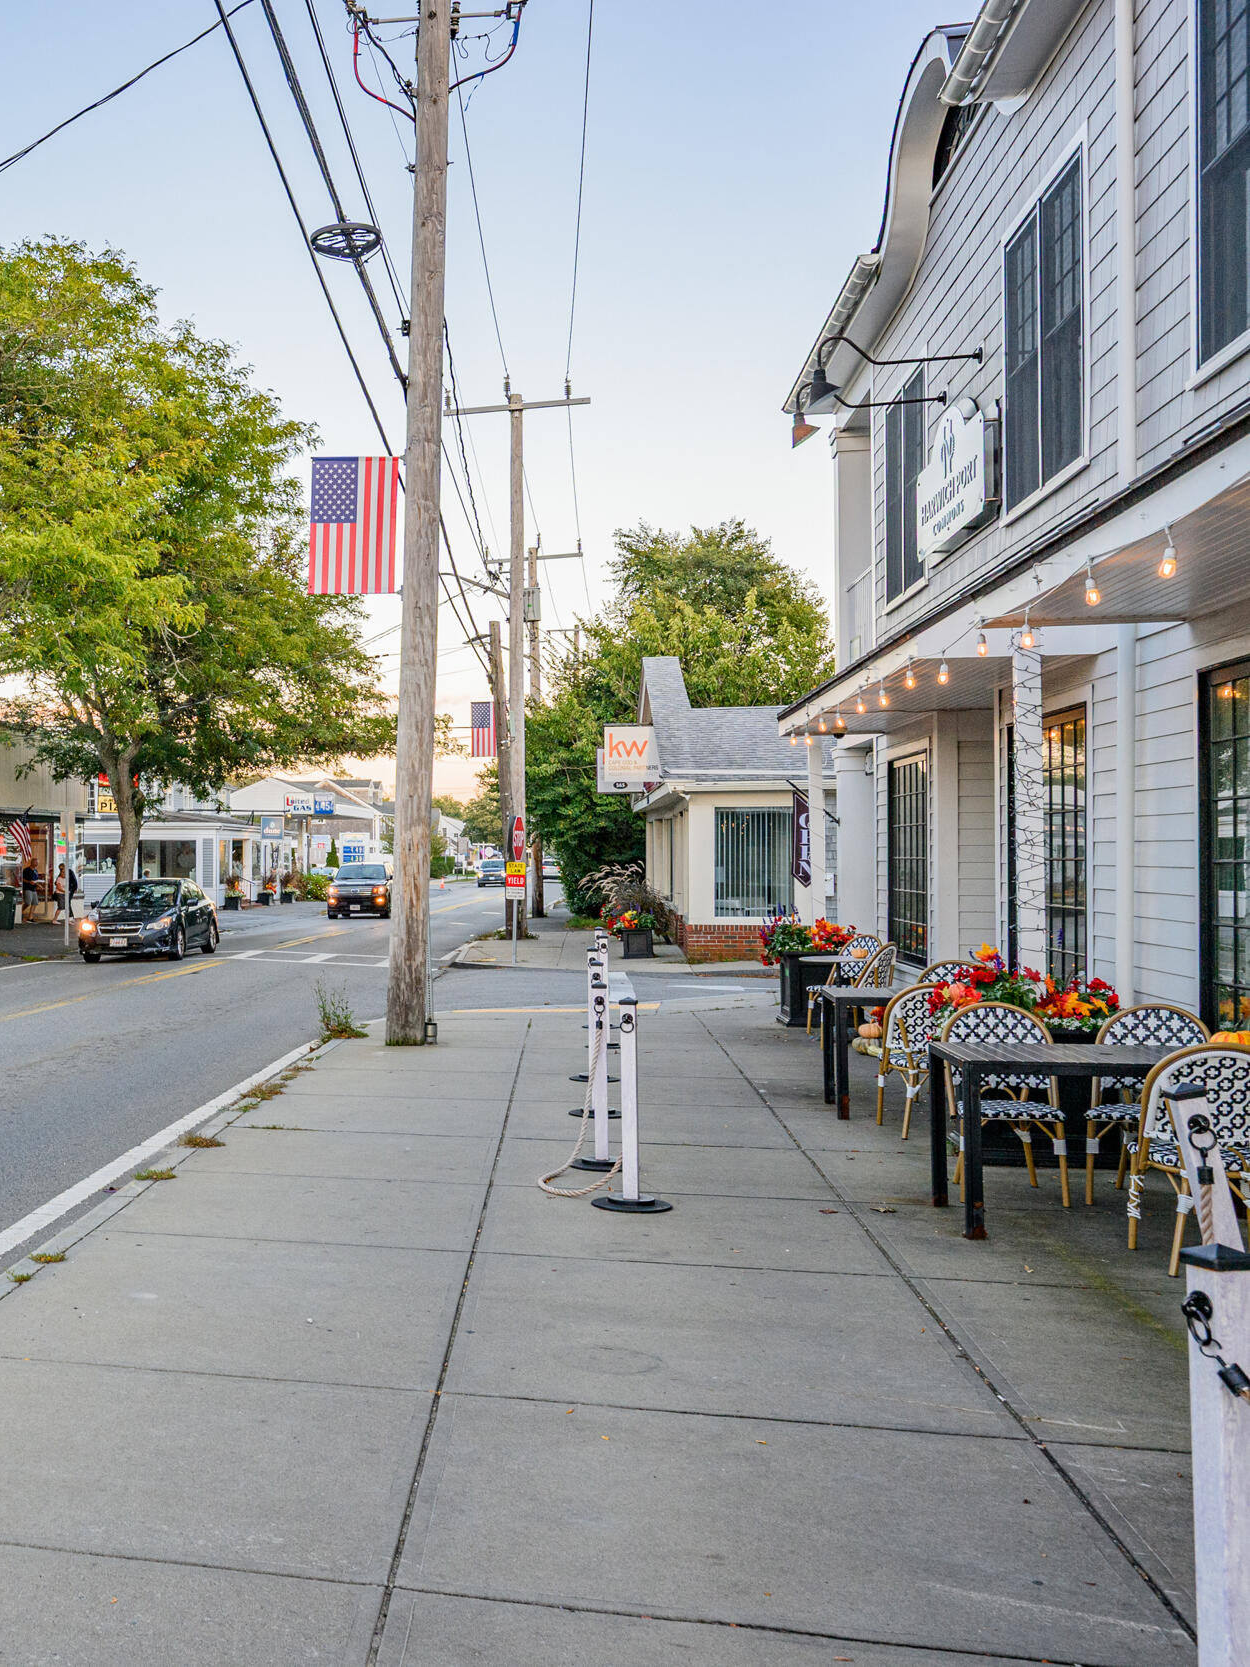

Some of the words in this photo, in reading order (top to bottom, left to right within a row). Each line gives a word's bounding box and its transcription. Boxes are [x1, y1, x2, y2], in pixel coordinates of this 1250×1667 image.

[921, 476, 956, 527] HARWICH
[956, 454, 979, 494] PORT
[933, 499, 965, 536] COMMONS
[286, 796, 310, 806] United
[293, 804, 312, 812] GAS
[513, 830, 524, 847] STOP
[507, 876, 525, 885] YIELD
